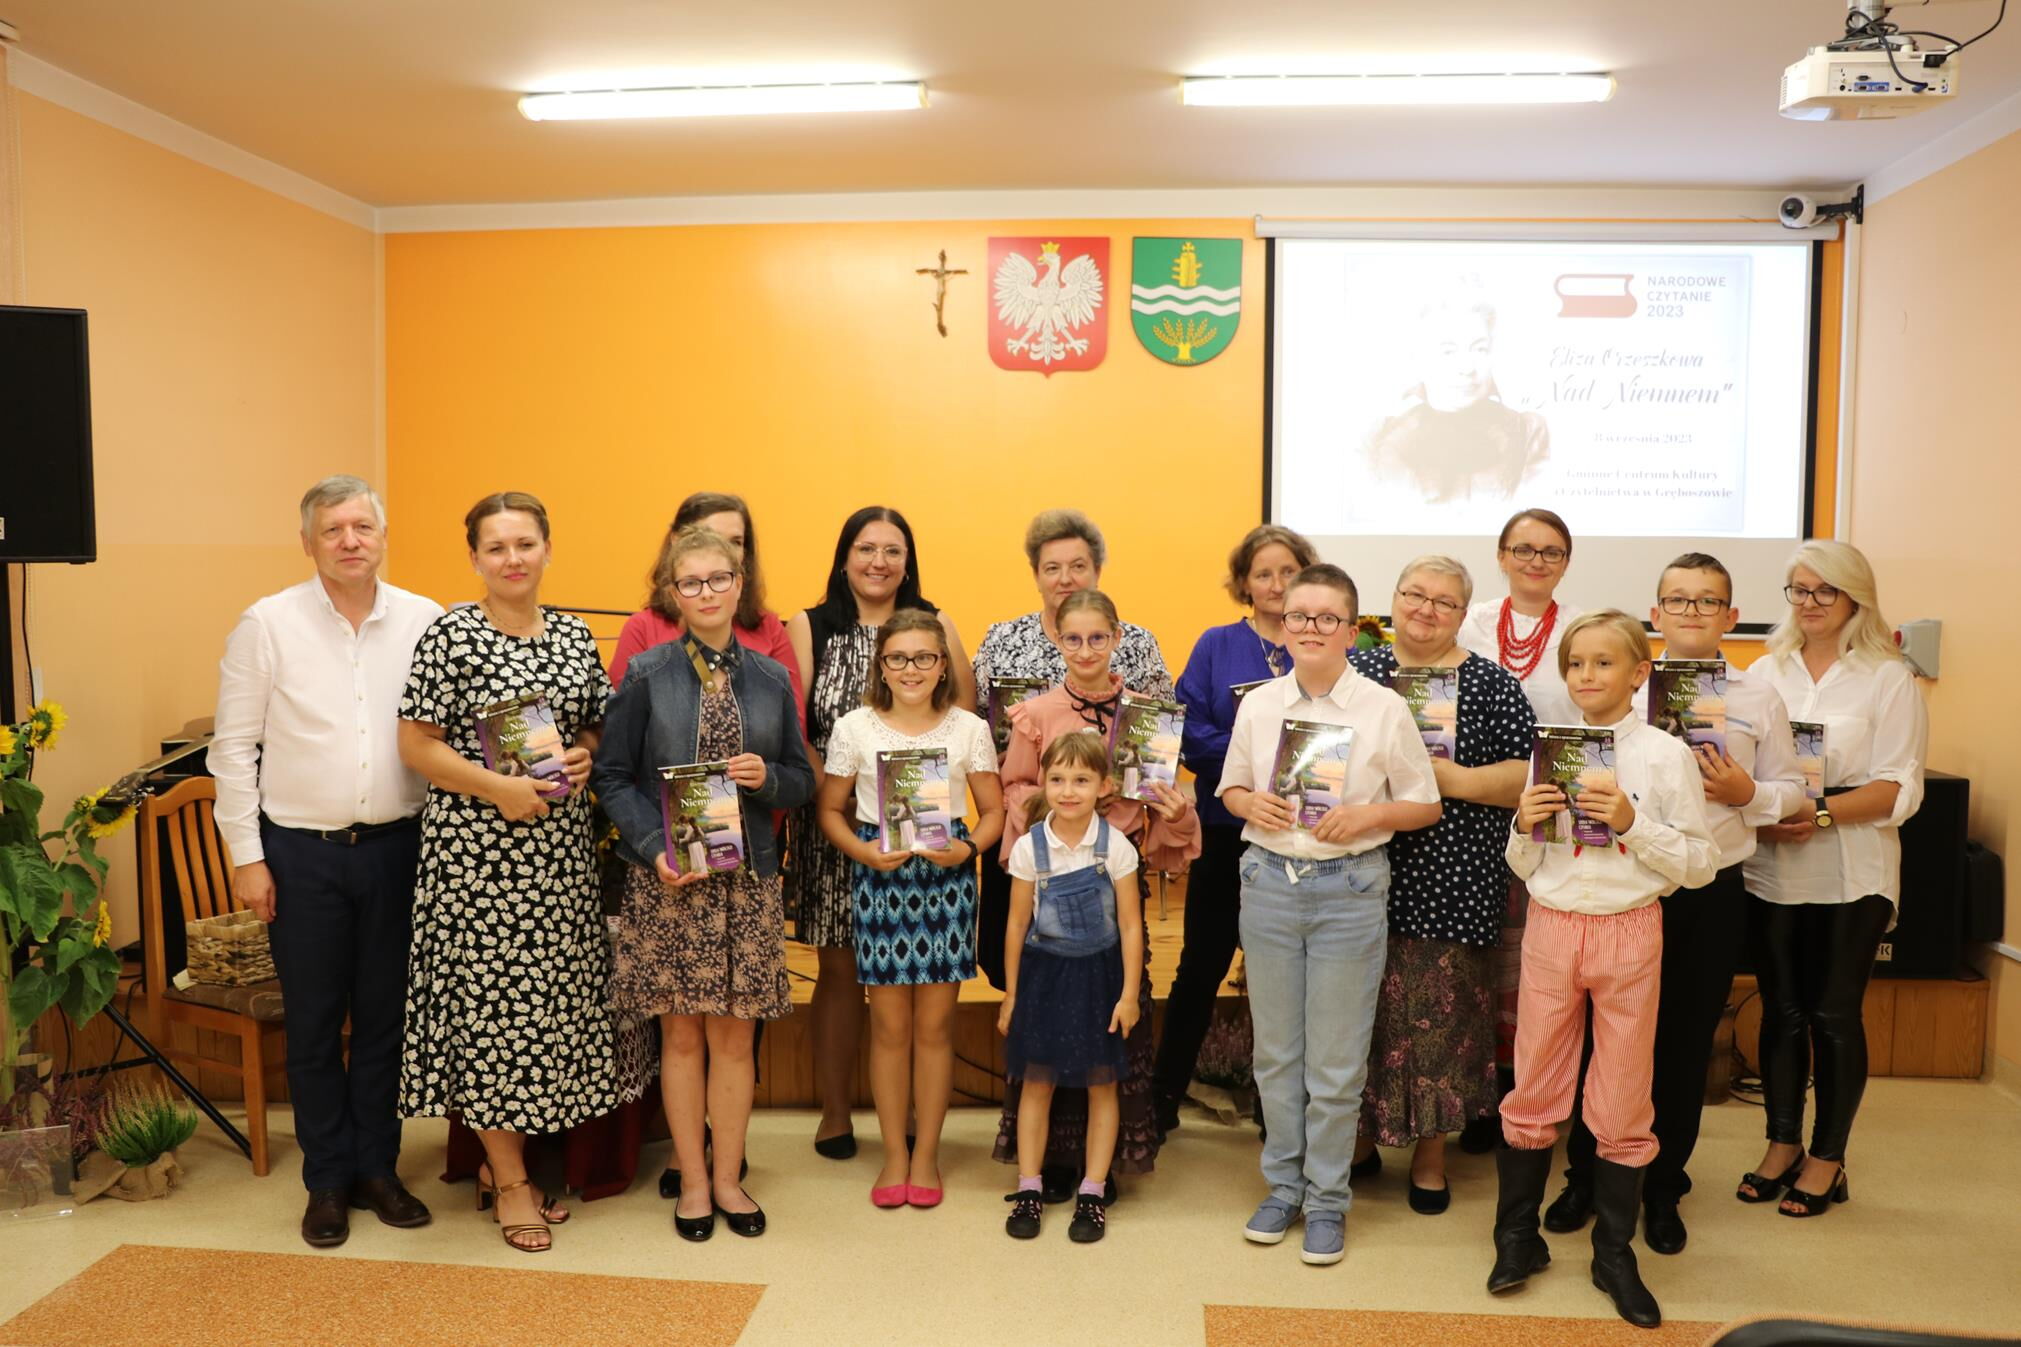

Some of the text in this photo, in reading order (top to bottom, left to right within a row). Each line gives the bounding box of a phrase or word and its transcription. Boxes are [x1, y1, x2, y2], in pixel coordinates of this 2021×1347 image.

[1647, 275, 1727, 288] NARODOWE
[1647, 290, 1712, 302] CZYTANIE
[1647, 304, 1685, 318] 2023
[1414, 687, 1432, 697] Nad
[1681, 682, 1701, 693] Nad
[509, 718, 530, 732] Nad
[1142, 719, 1160, 730] Nad
[1567, 752, 1588, 763] Nad
[907, 769, 926, 779] Nad
[693, 786, 713, 798] Nad
